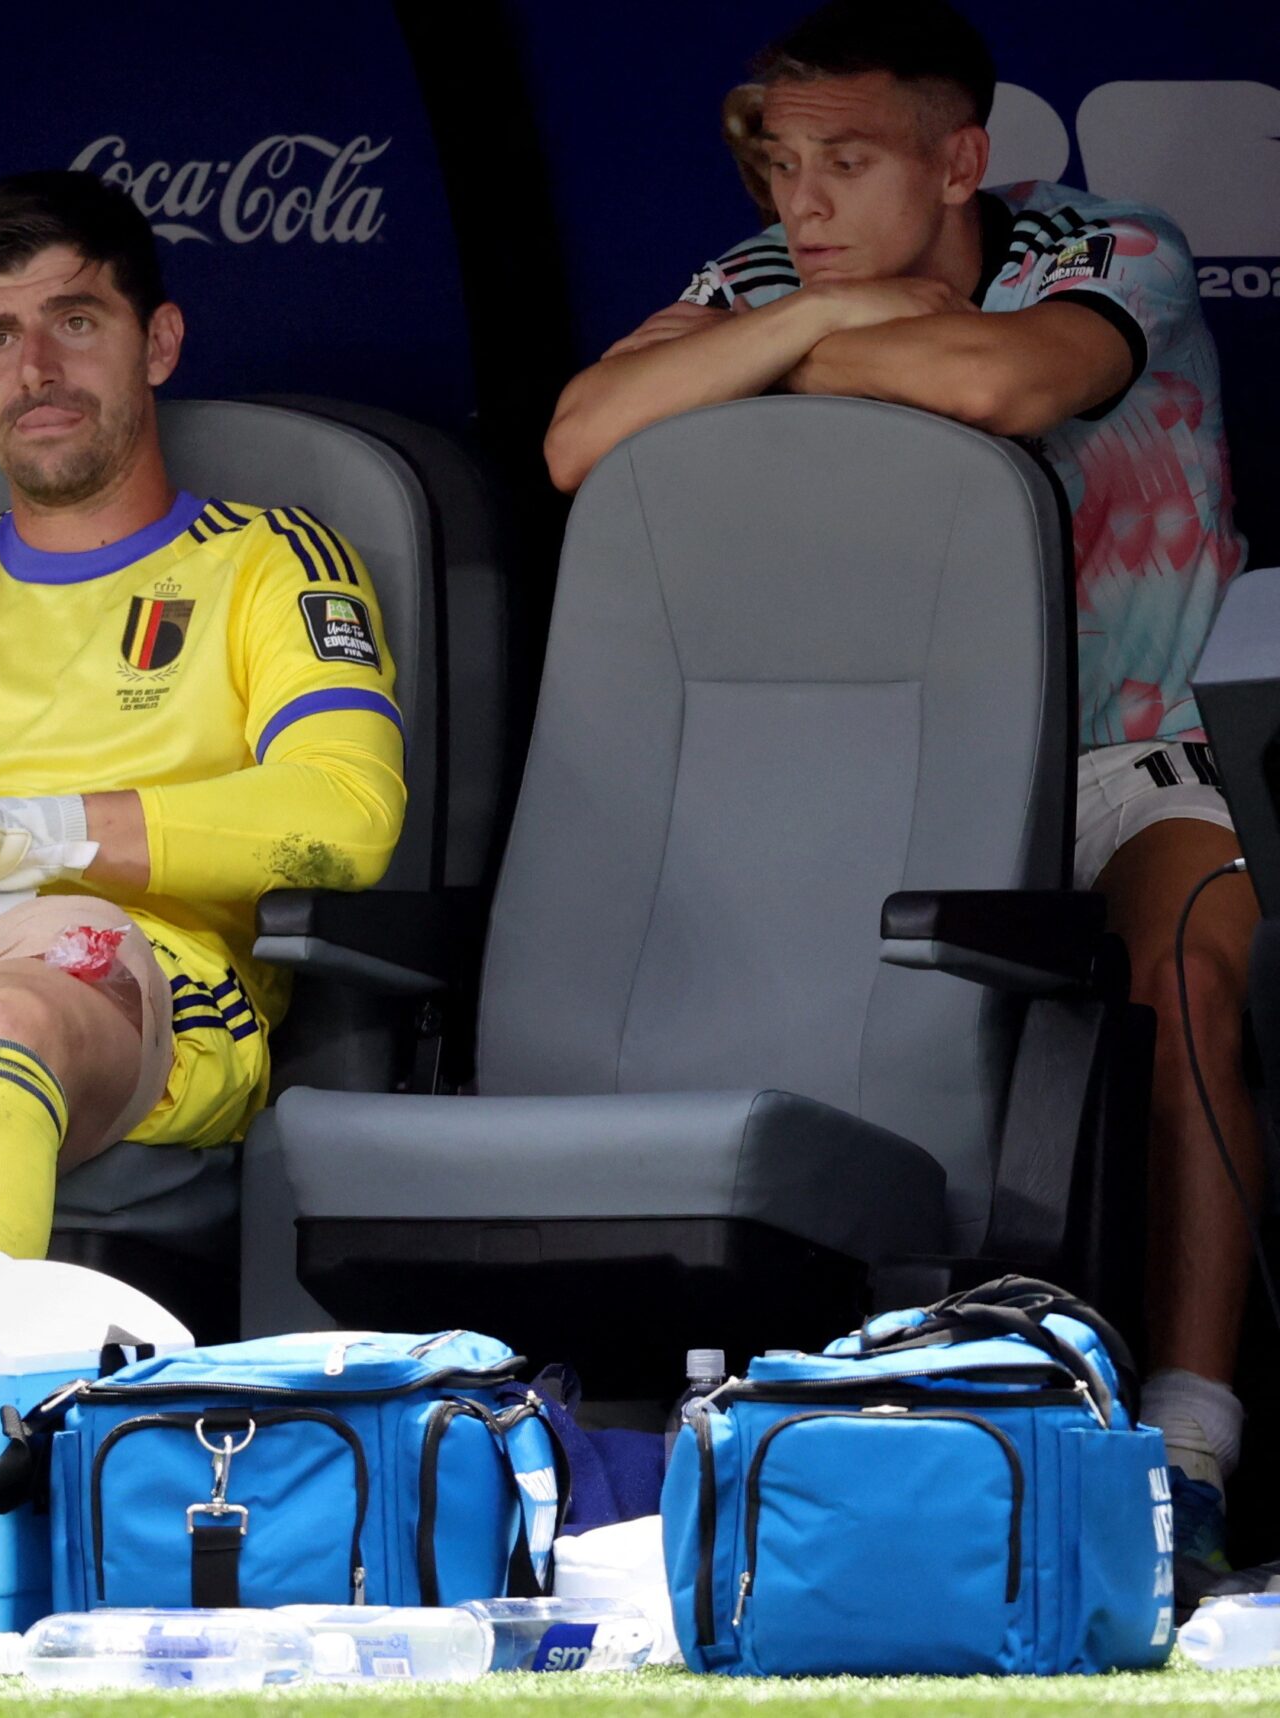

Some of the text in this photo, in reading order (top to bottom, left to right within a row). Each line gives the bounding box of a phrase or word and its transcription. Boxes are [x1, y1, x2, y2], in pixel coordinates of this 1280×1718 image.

[1197, 265, 1280, 298] 20
[327, 622, 352, 635] Unite
[323, 635, 375, 656] EDUCATION
